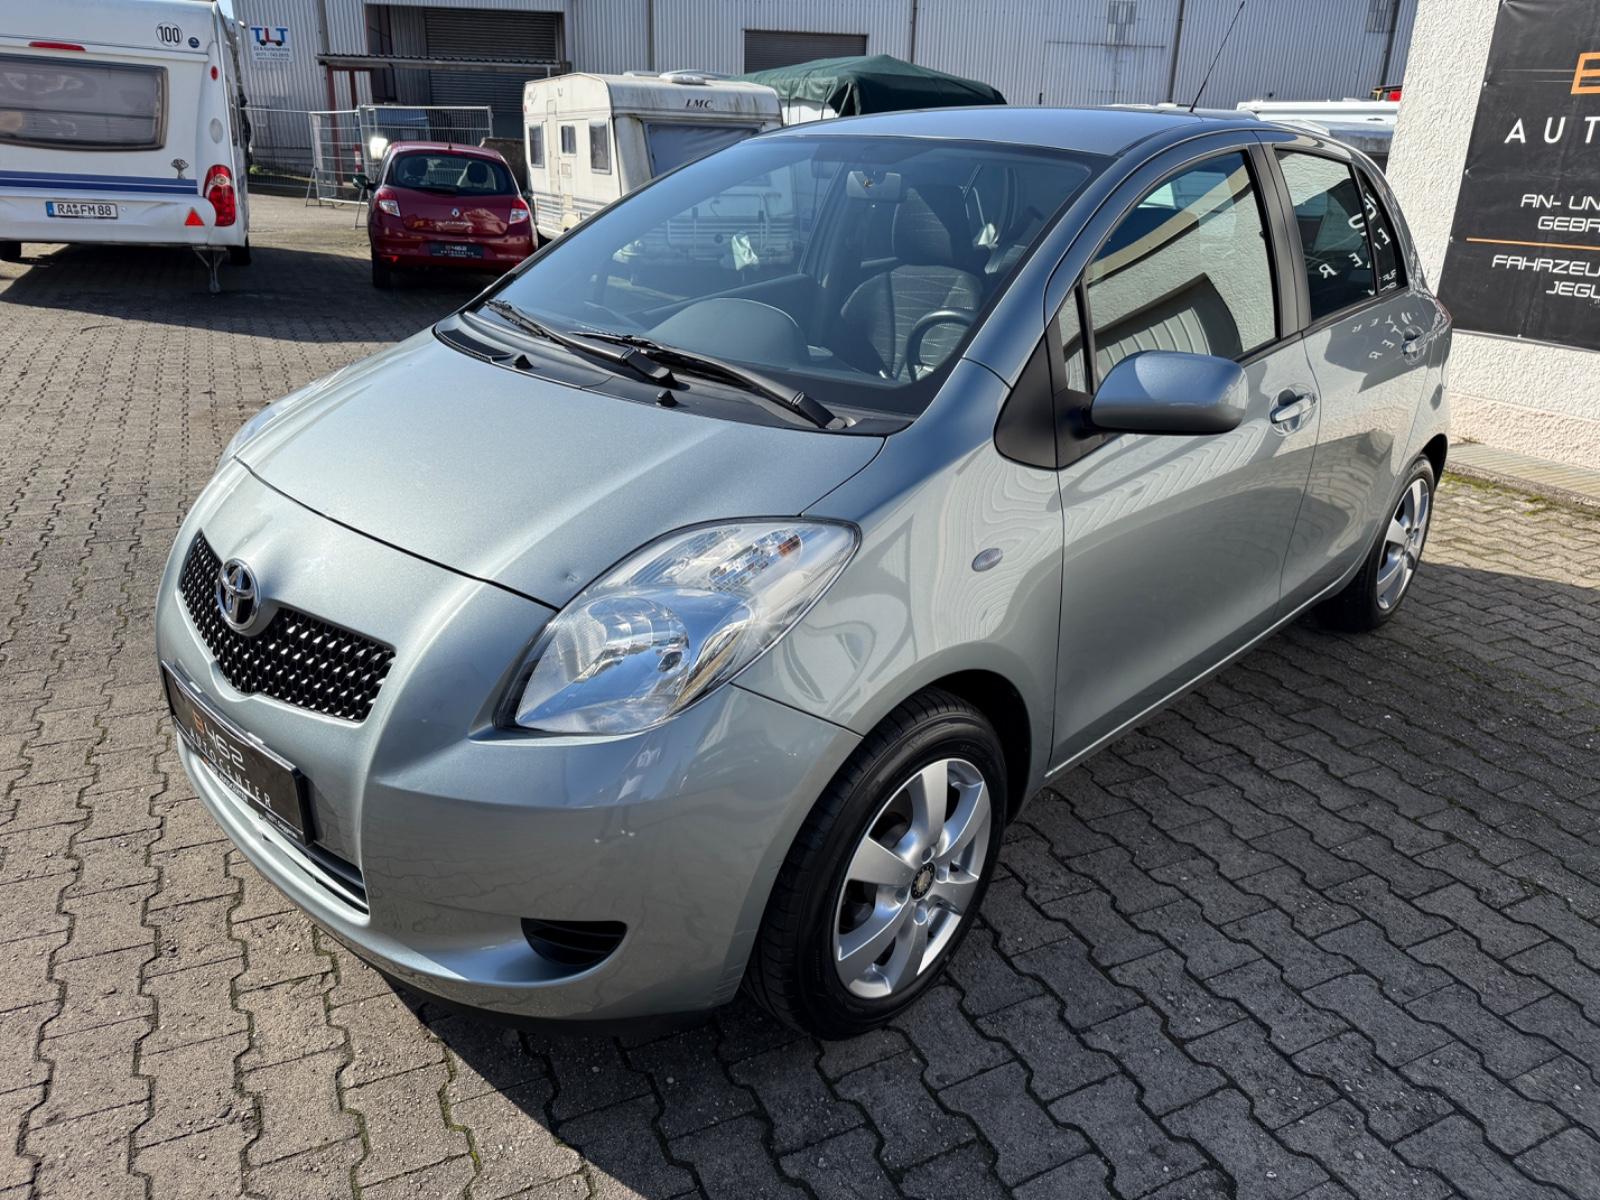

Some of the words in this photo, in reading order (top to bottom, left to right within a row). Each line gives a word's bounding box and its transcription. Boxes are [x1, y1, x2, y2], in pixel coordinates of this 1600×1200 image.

[158, 26, 180, 43] 100
[250, 27, 289, 44] TLT
[1503, 116, 1600, 145] AUT
[57, 203, 74, 215] RA
[80, 204, 96, 215] FM
[97, 205, 112, 216] 88
[1520, 193, 1562, 209] AN-
[1568, 195, 1600, 211] UN
[1491, 254, 1600, 278] FAHRZEU
